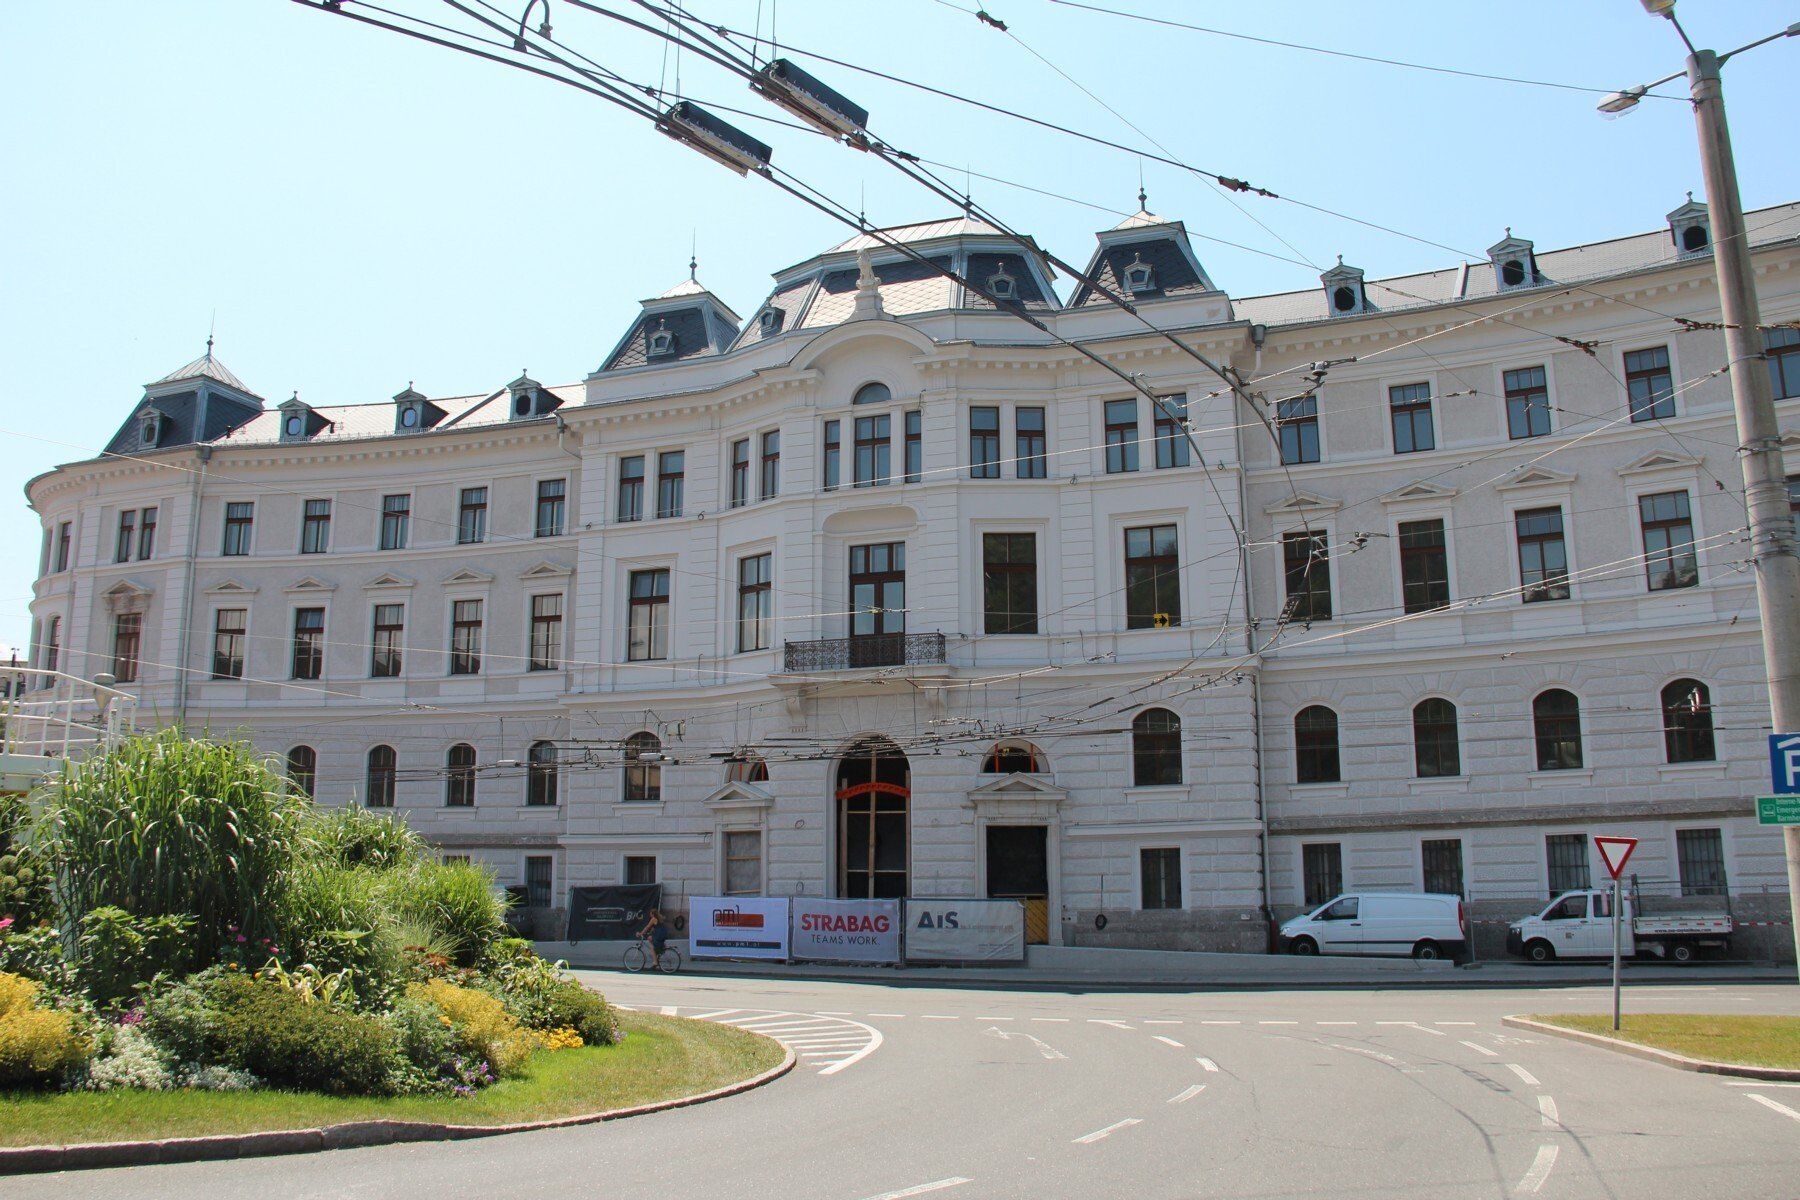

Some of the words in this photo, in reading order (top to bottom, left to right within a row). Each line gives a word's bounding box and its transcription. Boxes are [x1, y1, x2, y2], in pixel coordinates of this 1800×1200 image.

[801, 914, 890, 933] STRABAG
[811, 933, 844, 945] TEAMS
[847, 935, 881, 946] WORK.
